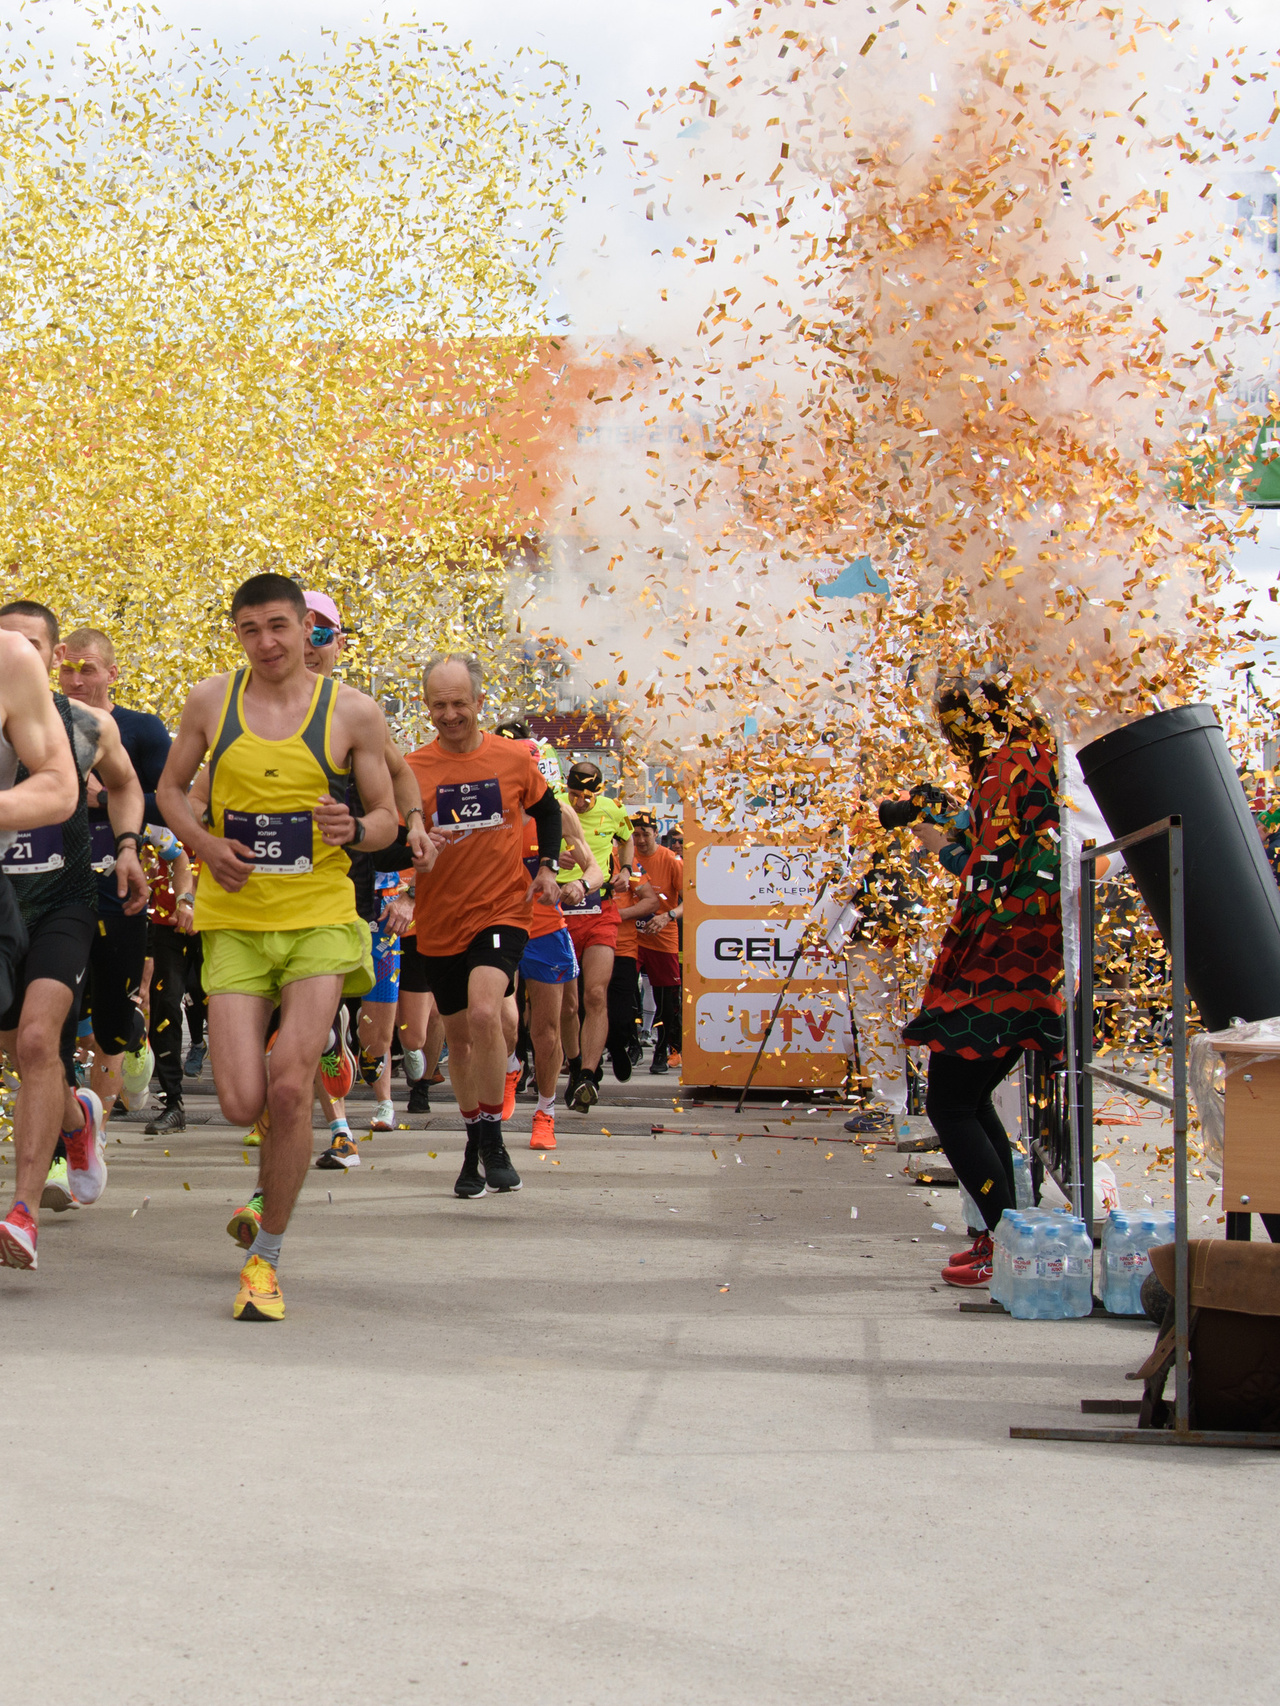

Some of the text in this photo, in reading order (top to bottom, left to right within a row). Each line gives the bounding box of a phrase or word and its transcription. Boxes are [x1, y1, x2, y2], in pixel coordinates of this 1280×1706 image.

[460, 803, 482, 817] 42
[12, 842, 33, 859] 21
[253, 841, 282, 859] 56
[741, 1009, 833, 1042] UTV
